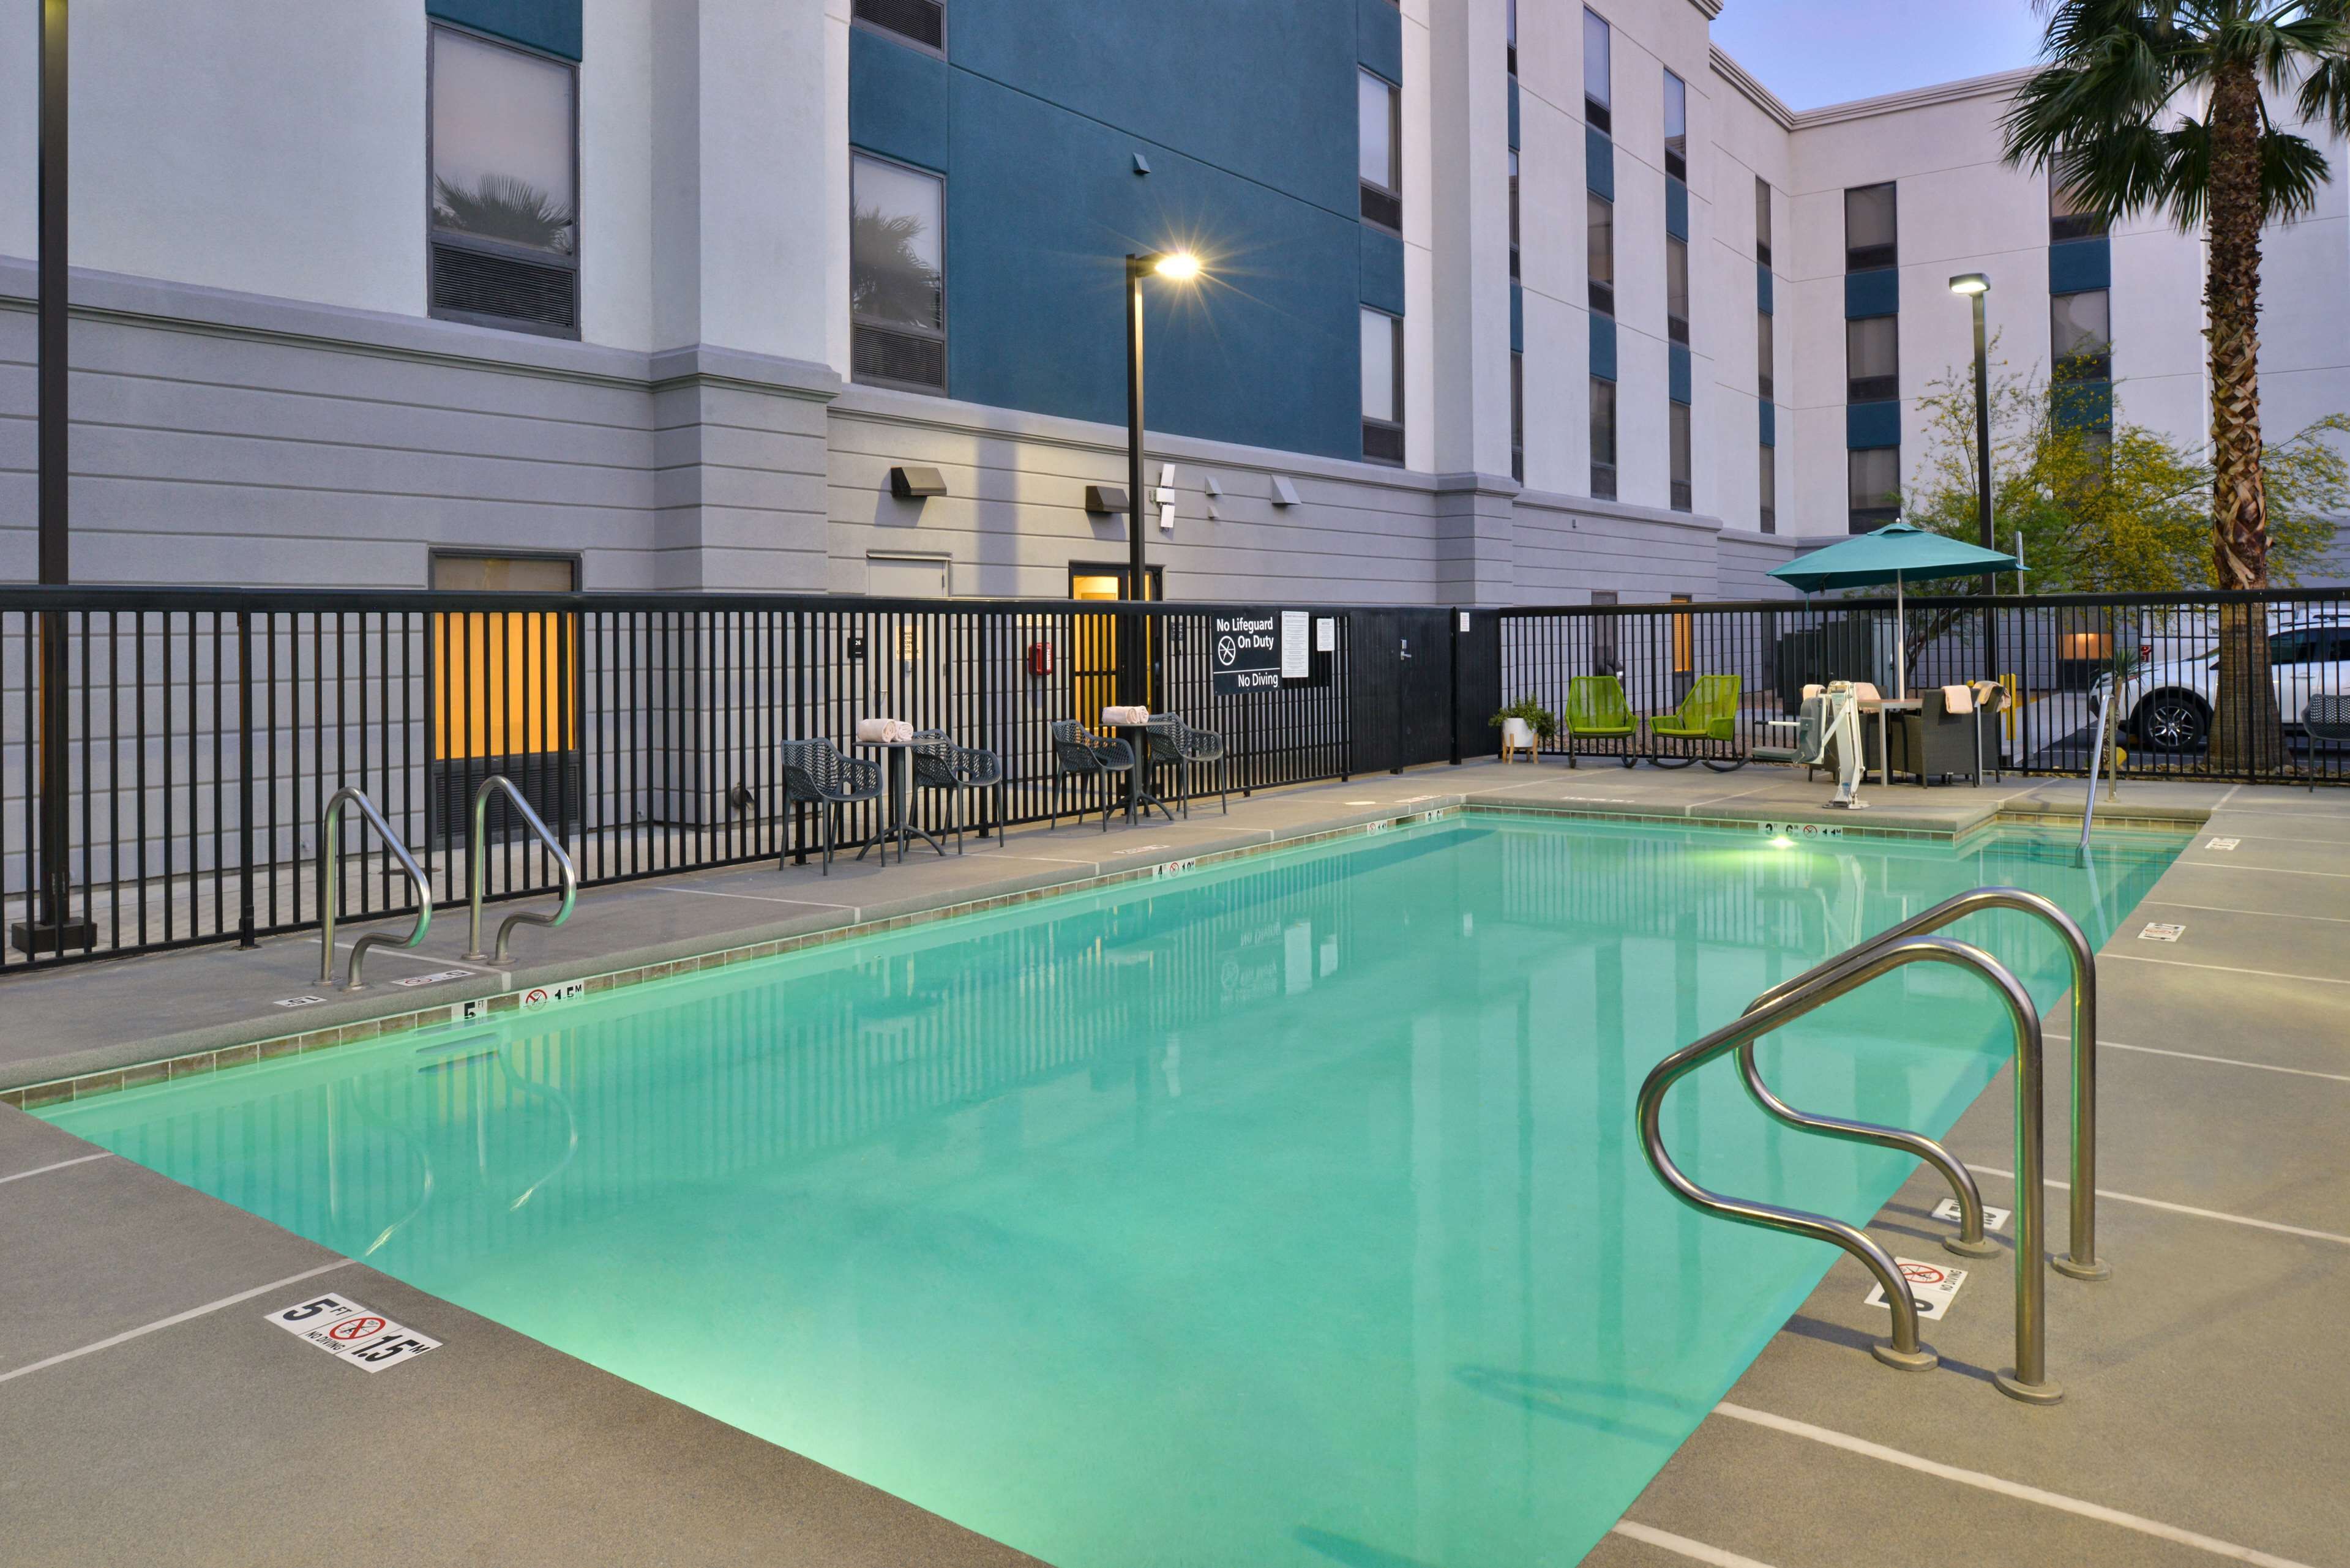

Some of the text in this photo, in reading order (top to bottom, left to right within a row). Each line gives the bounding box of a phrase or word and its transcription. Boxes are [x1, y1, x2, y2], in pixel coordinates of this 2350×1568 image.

[1217, 617, 1273, 633] No Lifeguard
[1238, 635, 1274, 650] On Duty
[1238, 672, 1278, 687] No Diving
[575, 984, 582, 993] M
[464, 1001, 476, 1019] 5
[283, 1298, 353, 1321] 5 FT
[305, 1331, 346, 1351] NO DIVING
[351, 1335, 430, 1362] 1.5 M
